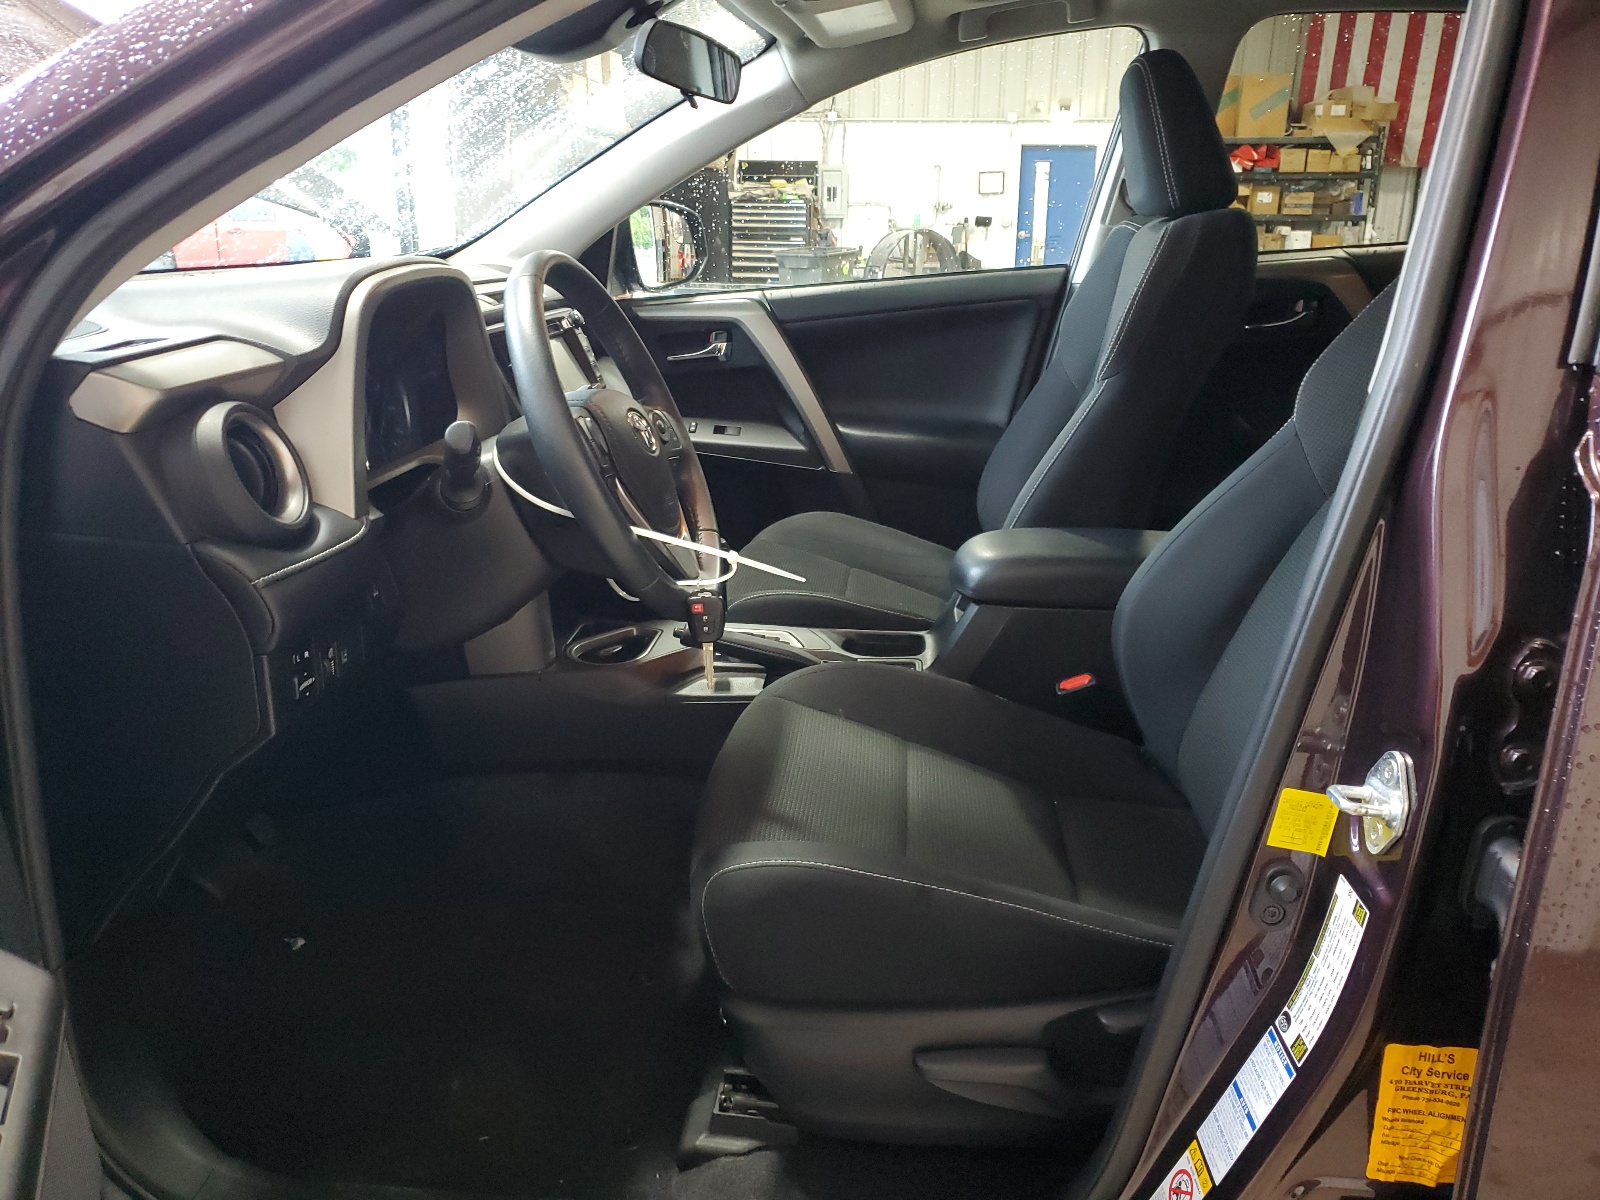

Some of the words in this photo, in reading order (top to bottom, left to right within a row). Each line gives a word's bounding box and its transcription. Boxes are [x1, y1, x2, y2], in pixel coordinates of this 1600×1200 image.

[1418, 1051, 1455, 1064] HILL'S
[1401, 1065, 1423, 1079] City
[1425, 1067, 1470, 1081] Service
[1402, 1108, 1427, 1117] WHEEL
